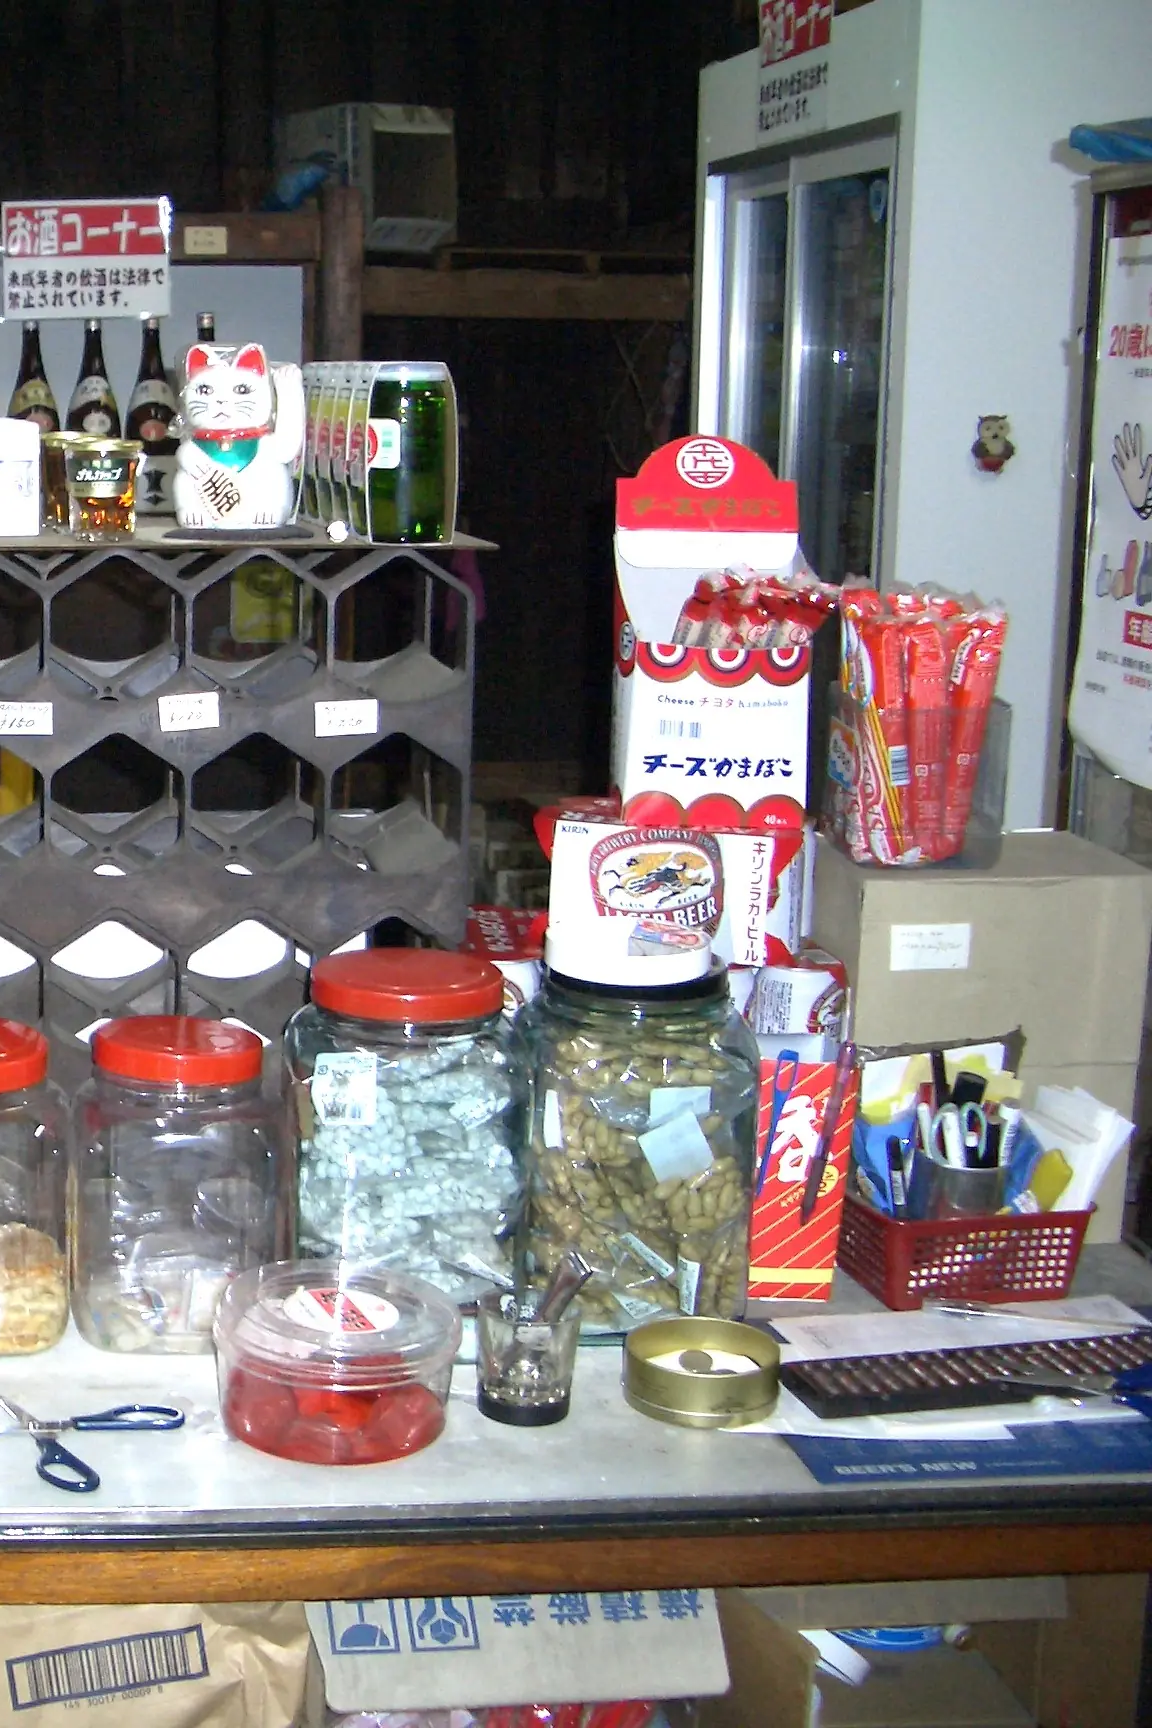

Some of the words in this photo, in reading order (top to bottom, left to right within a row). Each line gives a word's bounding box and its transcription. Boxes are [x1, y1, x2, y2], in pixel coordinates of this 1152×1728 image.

[7, 208, 164, 255] お酒コーナー
[8, 268, 164, 288] 未成年者の飲酒は法律で
[8, 290, 129, 308] 禁止されています。
[643, 754, 793, 778] チーズかまぼこ
[561, 824, 589, 835] KIRIN
[673, 896, 717, 926] BEER
